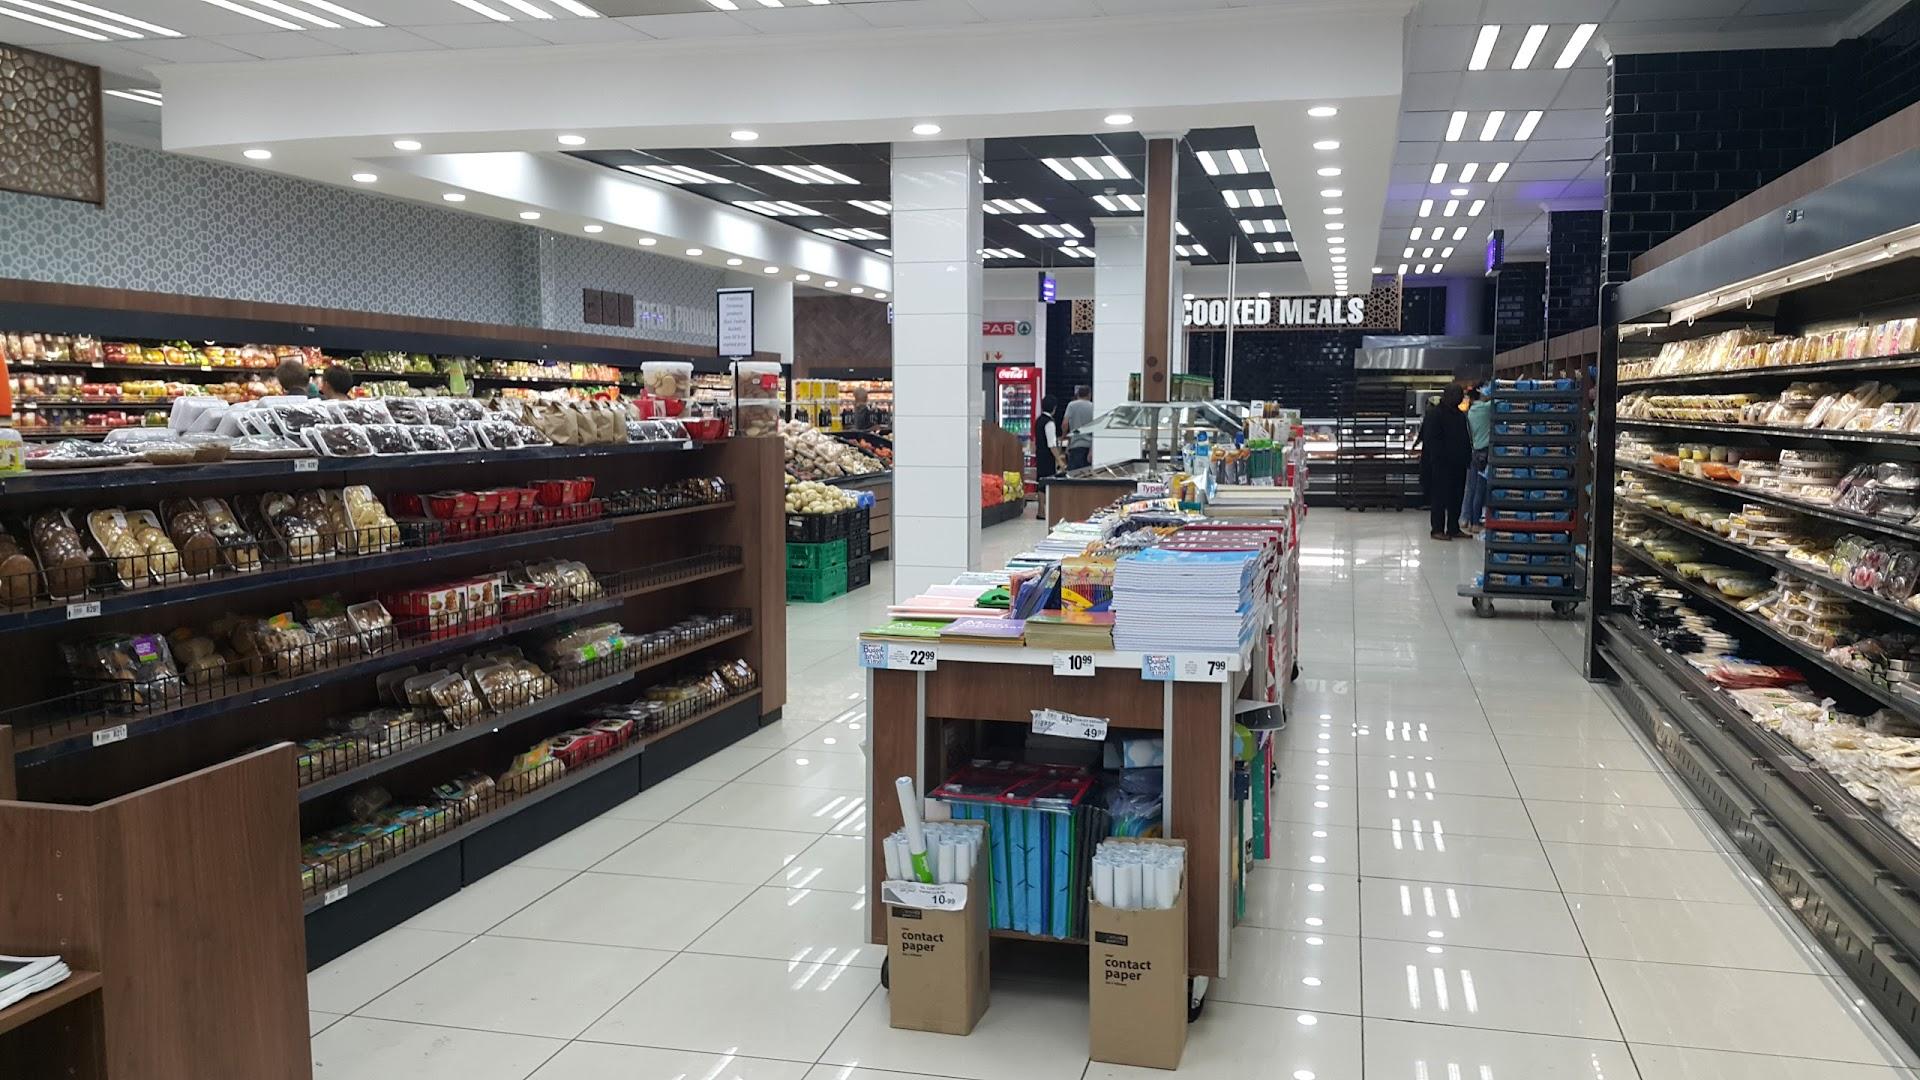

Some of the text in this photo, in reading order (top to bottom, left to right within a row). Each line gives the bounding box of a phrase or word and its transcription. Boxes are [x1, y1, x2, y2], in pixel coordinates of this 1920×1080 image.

[1184, 297, 1365, 326] COOKED MEALS
[635, 300, 672, 331] FRESH
[675, 305, 716, 337] PRODUC
[983, 323, 1014, 334] PAR
[902, 931, 944, 943] contact
[902, 942, 935, 953] paper
[1105, 959, 1152, 970] contact
[1105, 970, 1142, 982] paper
